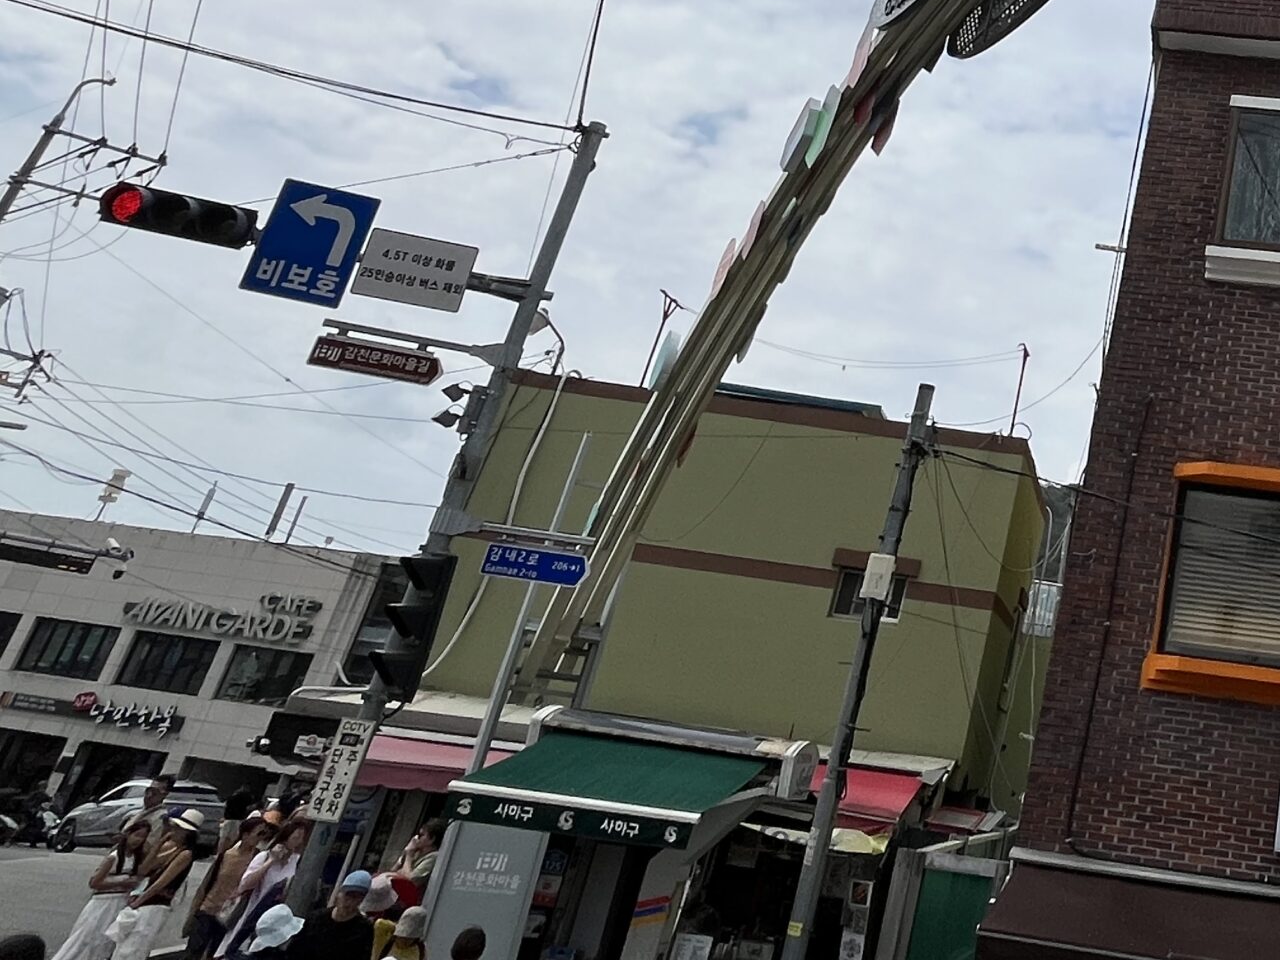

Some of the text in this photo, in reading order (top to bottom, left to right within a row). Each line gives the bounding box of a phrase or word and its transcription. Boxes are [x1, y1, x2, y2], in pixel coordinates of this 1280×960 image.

[382, 248, 408, 262] 4.5T
[411, 253, 433, 269] 이상
[256, 258, 340, 298] 비보호
[419, 278, 439, 291] 버스
[443, 282, 464, 295] 제외
[344, 345, 430, 374] 감천문화마을길
[490, 546, 539, 566] 감내2로
[263, 592, 316, 614] CAFE
[89, 700, 178, 740] 낭만한복
[342, 720, 370, 733] CCTV
[312, 748, 344, 815] 단속구역
[453, 871, 521, 889] 감천문화마을
